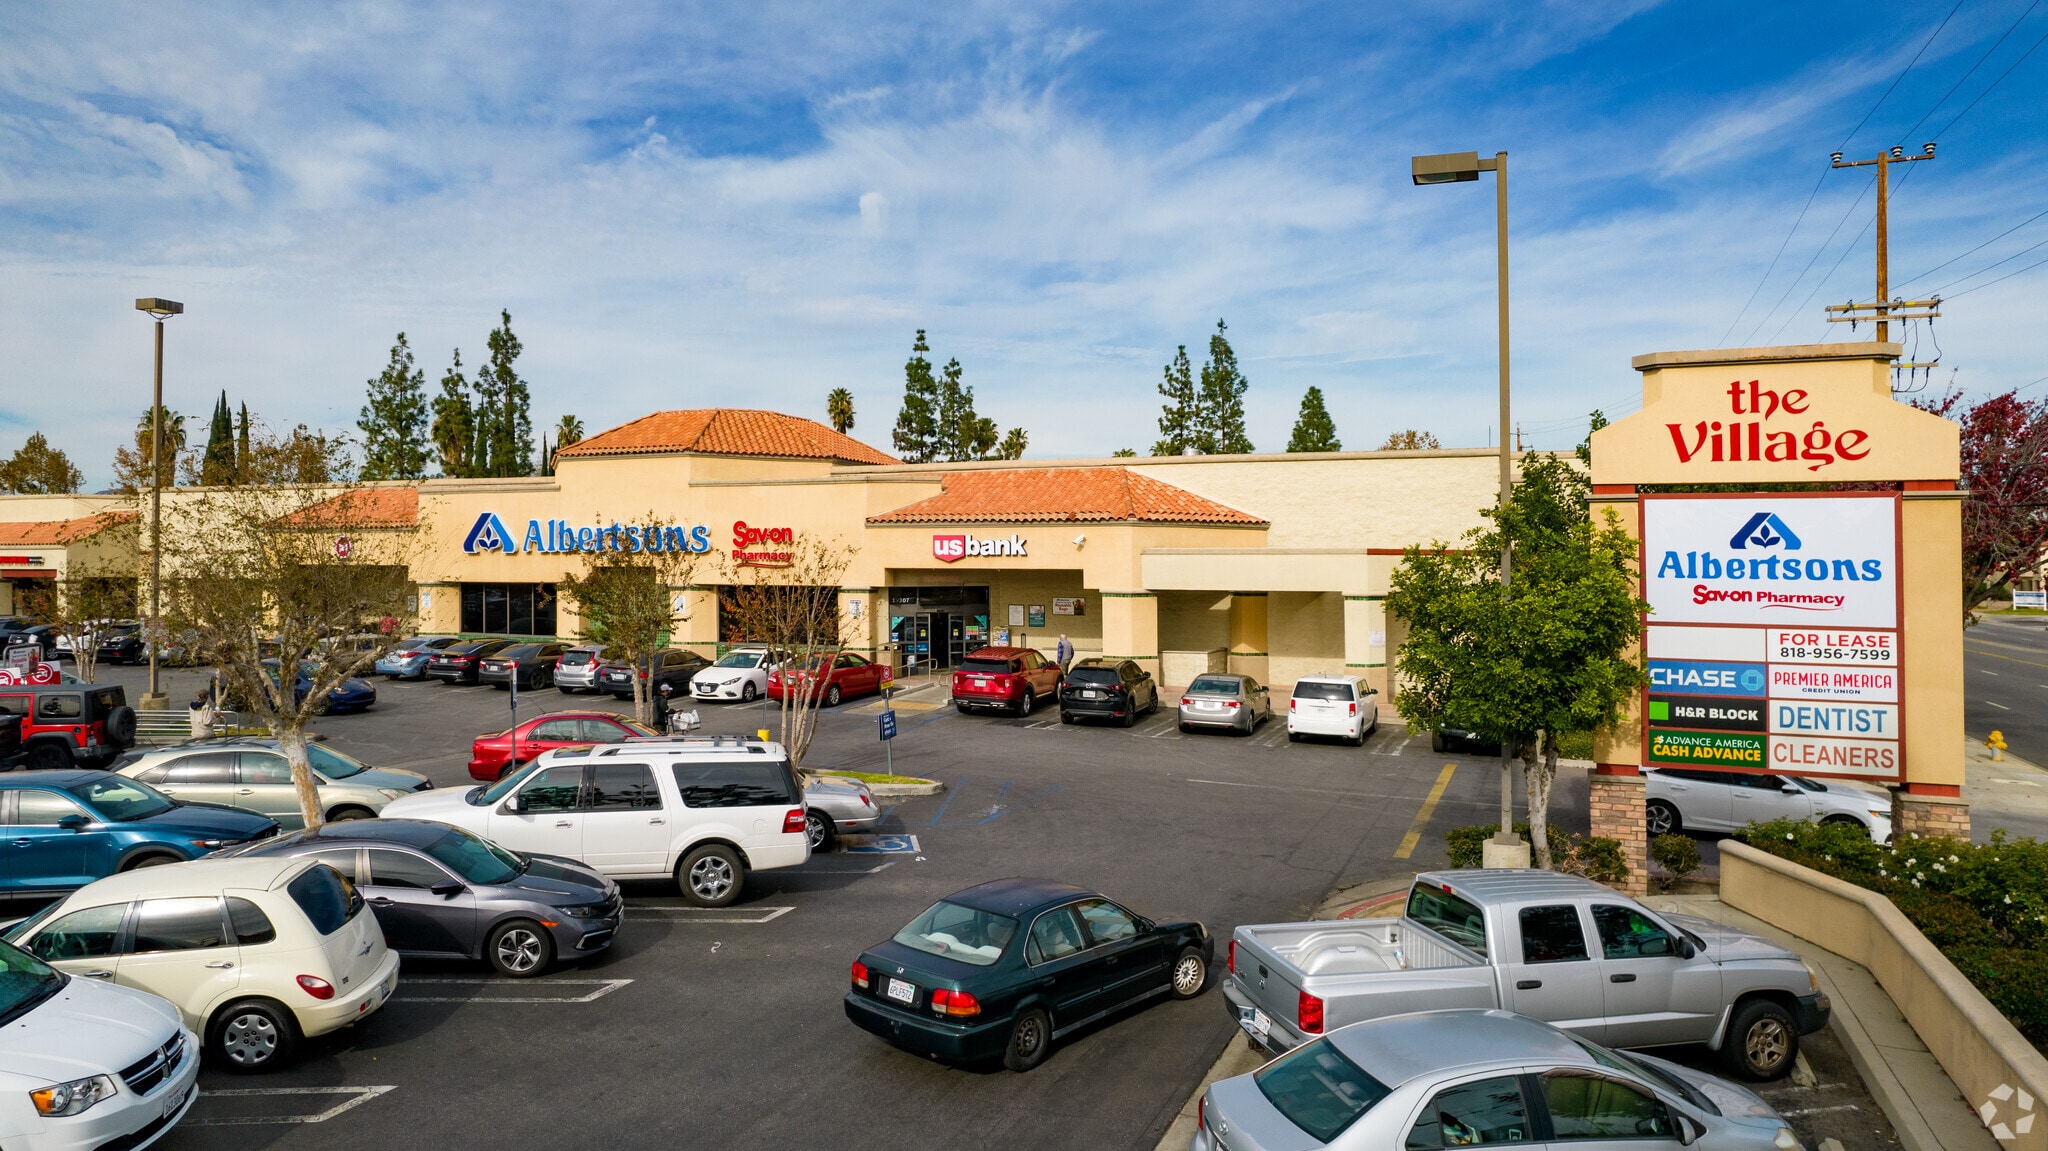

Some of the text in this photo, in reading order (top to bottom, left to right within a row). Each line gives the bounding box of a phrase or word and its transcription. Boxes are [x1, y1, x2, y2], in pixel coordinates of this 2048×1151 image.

[1726, 379, 1811, 421] the
[1665, 420, 1872, 472] Village
[522, 518, 712, 554] Albertsons
[731, 549, 793, 563] Pharmacy
[1657, 550, 1883, 582] Albertsons
[1756, 591, 1846, 607] Pharmacy
[1779, 633, 1890, 648] FOR LEASE
[1780, 647, 1890, 661] 818-956-7599
[1649, 668, 1737, 688] CHASE
[1774, 671, 1892, 689] PREMIER AMERICA
[1675, 706, 1759, 721] H&R BLOCK
[1779, 705, 1888, 733] DENTIST
[1665, 736, 1761, 749] ADVANCE AMERICA
[1653, 744, 1761, 761] CASH ADVANCE
[1773, 742, 1895, 769] CLEANERS
